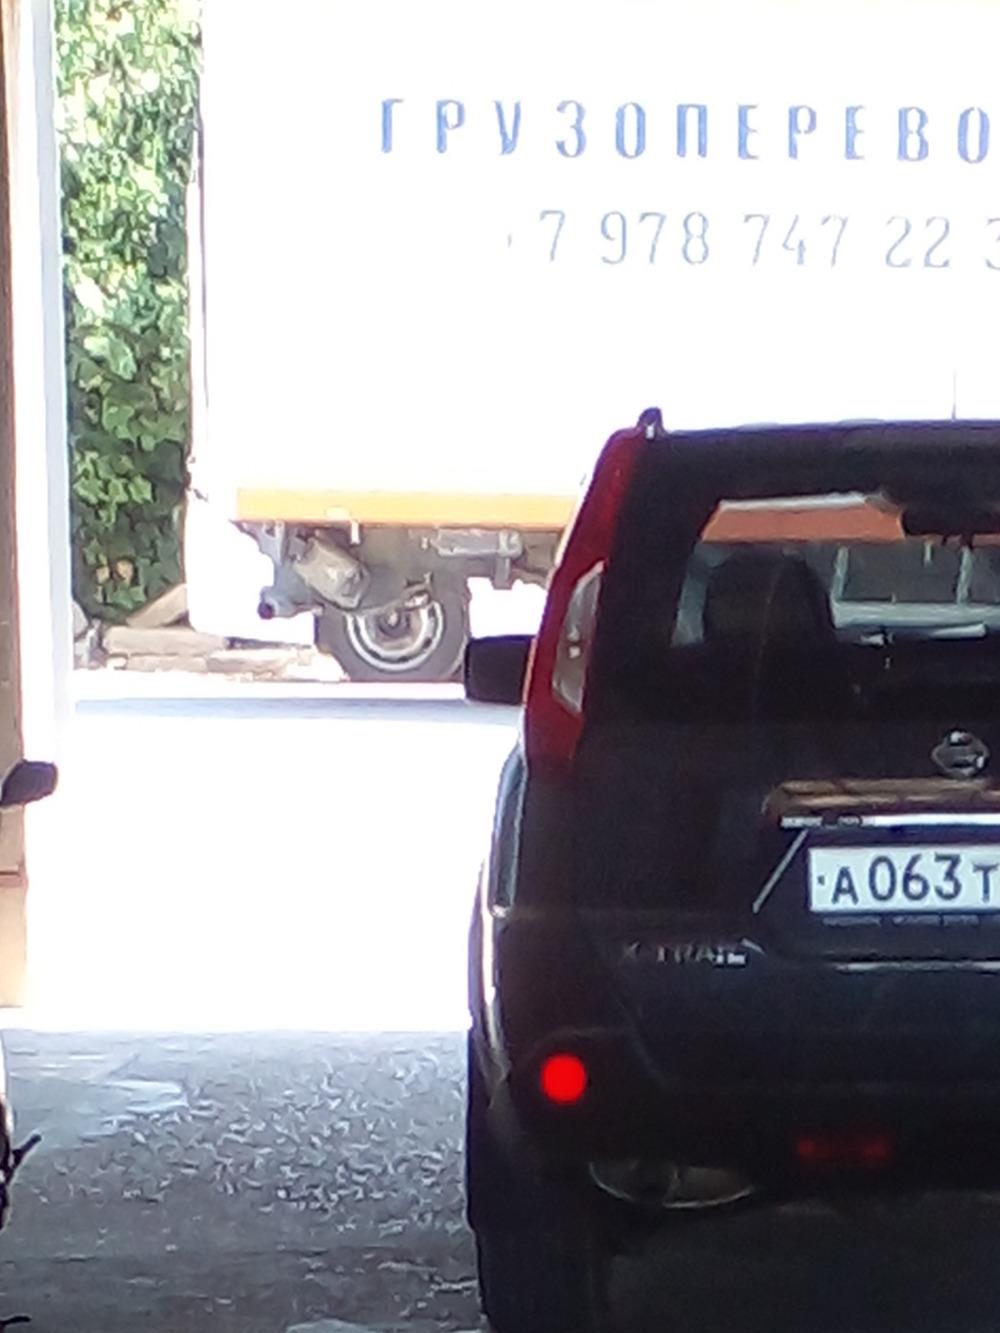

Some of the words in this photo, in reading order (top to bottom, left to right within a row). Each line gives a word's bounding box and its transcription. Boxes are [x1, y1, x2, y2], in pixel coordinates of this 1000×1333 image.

[599, 210, 710, 266] 978
[743, 212, 849, 267] 747
[884, 214, 951, 269] 22
